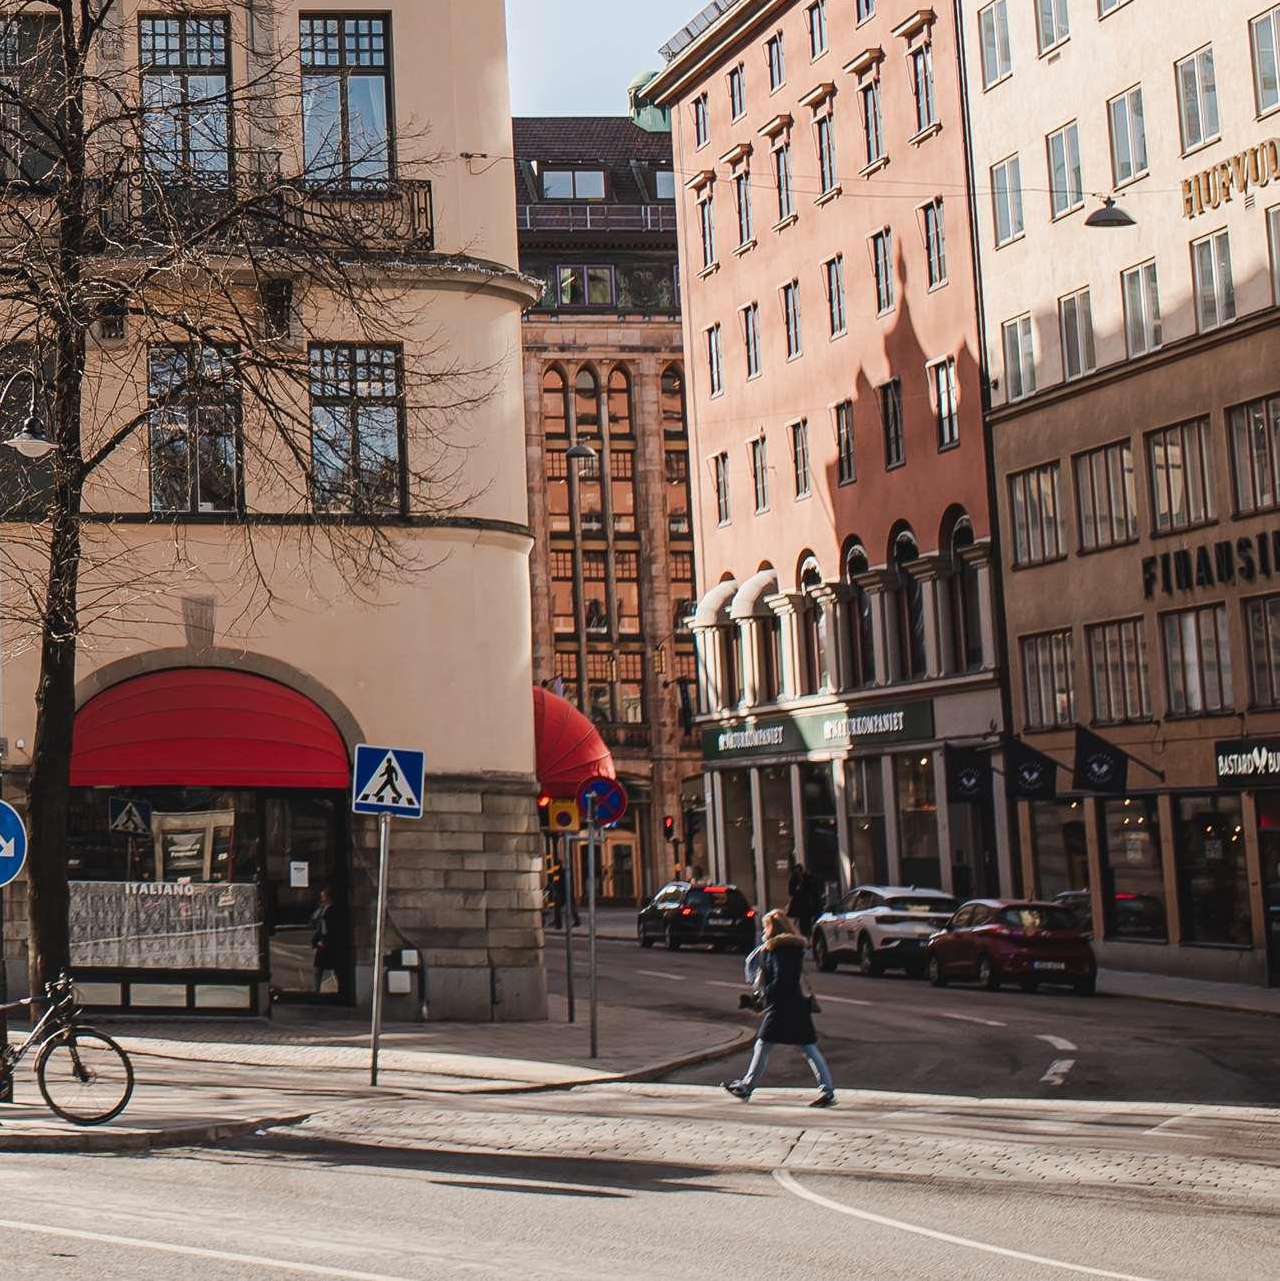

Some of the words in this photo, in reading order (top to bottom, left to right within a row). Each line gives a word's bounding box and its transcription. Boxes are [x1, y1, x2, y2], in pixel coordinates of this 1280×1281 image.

[1141, 529, 1280, 600] FINANSI
[1218, 753, 1255, 776] BASTARD
[125, 882, 194, 895] ITALIANO
